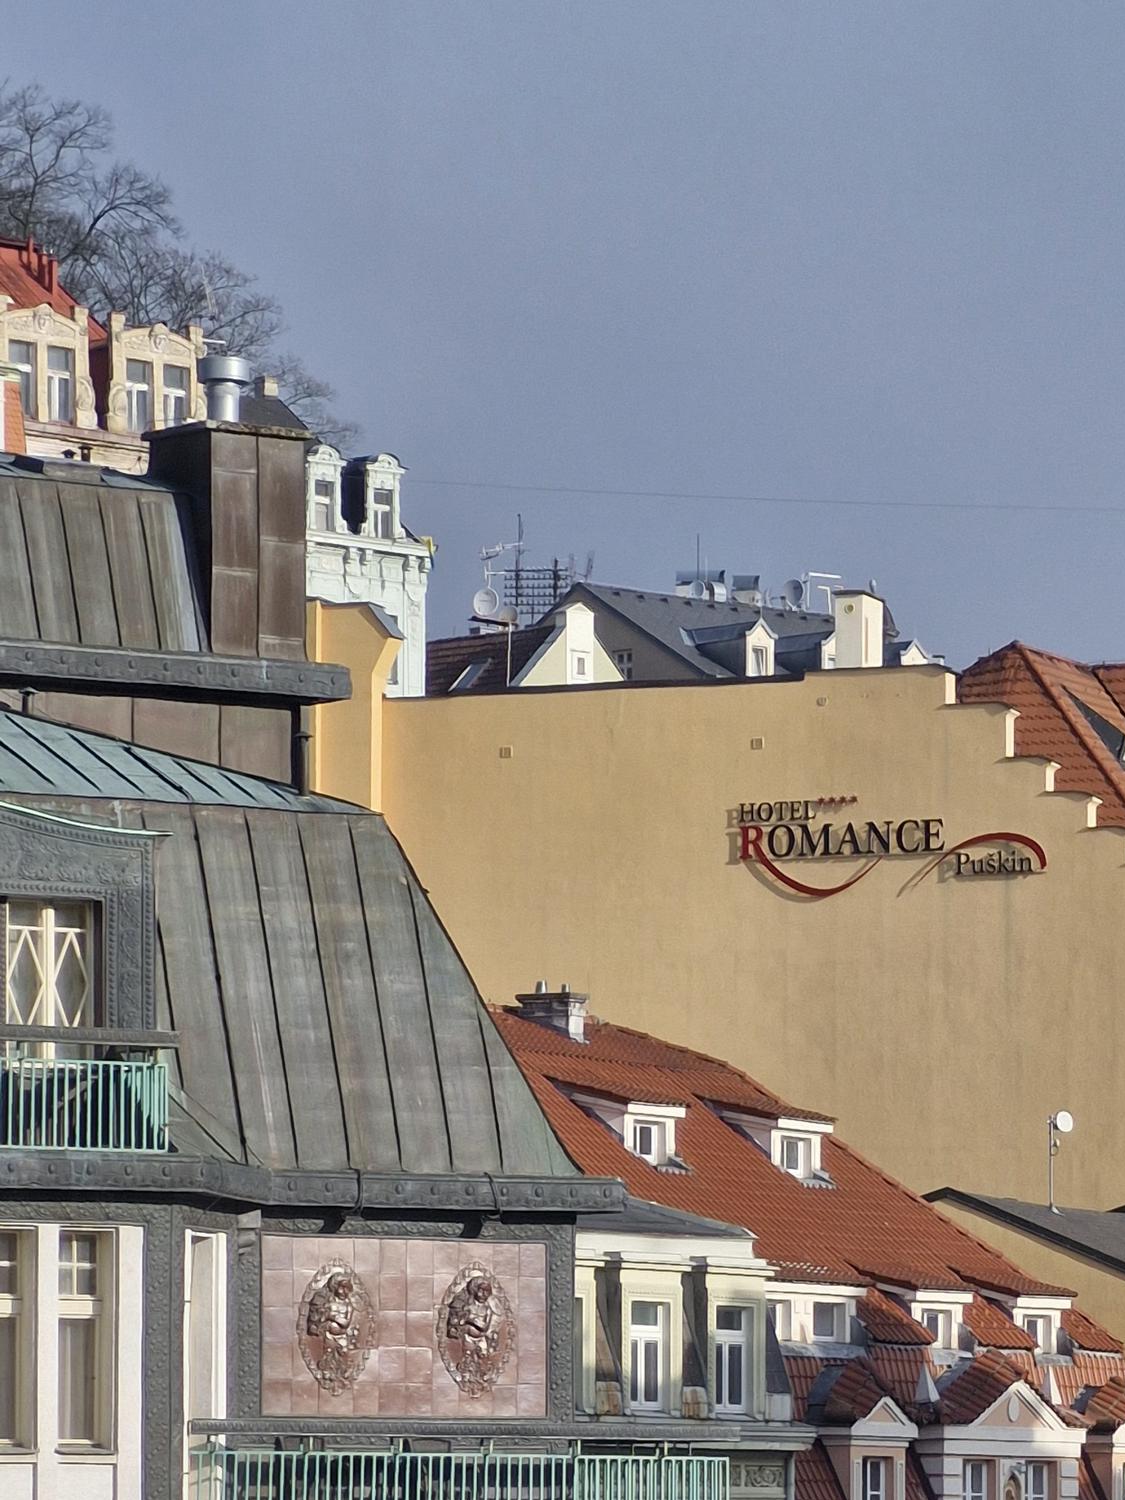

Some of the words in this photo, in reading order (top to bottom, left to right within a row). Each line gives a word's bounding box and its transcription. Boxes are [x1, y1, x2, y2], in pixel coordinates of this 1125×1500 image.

[740, 800, 816, 823] HOTEL
[739, 818, 946, 860] ROMANCE
[955, 850, 1033, 876] Puškin
